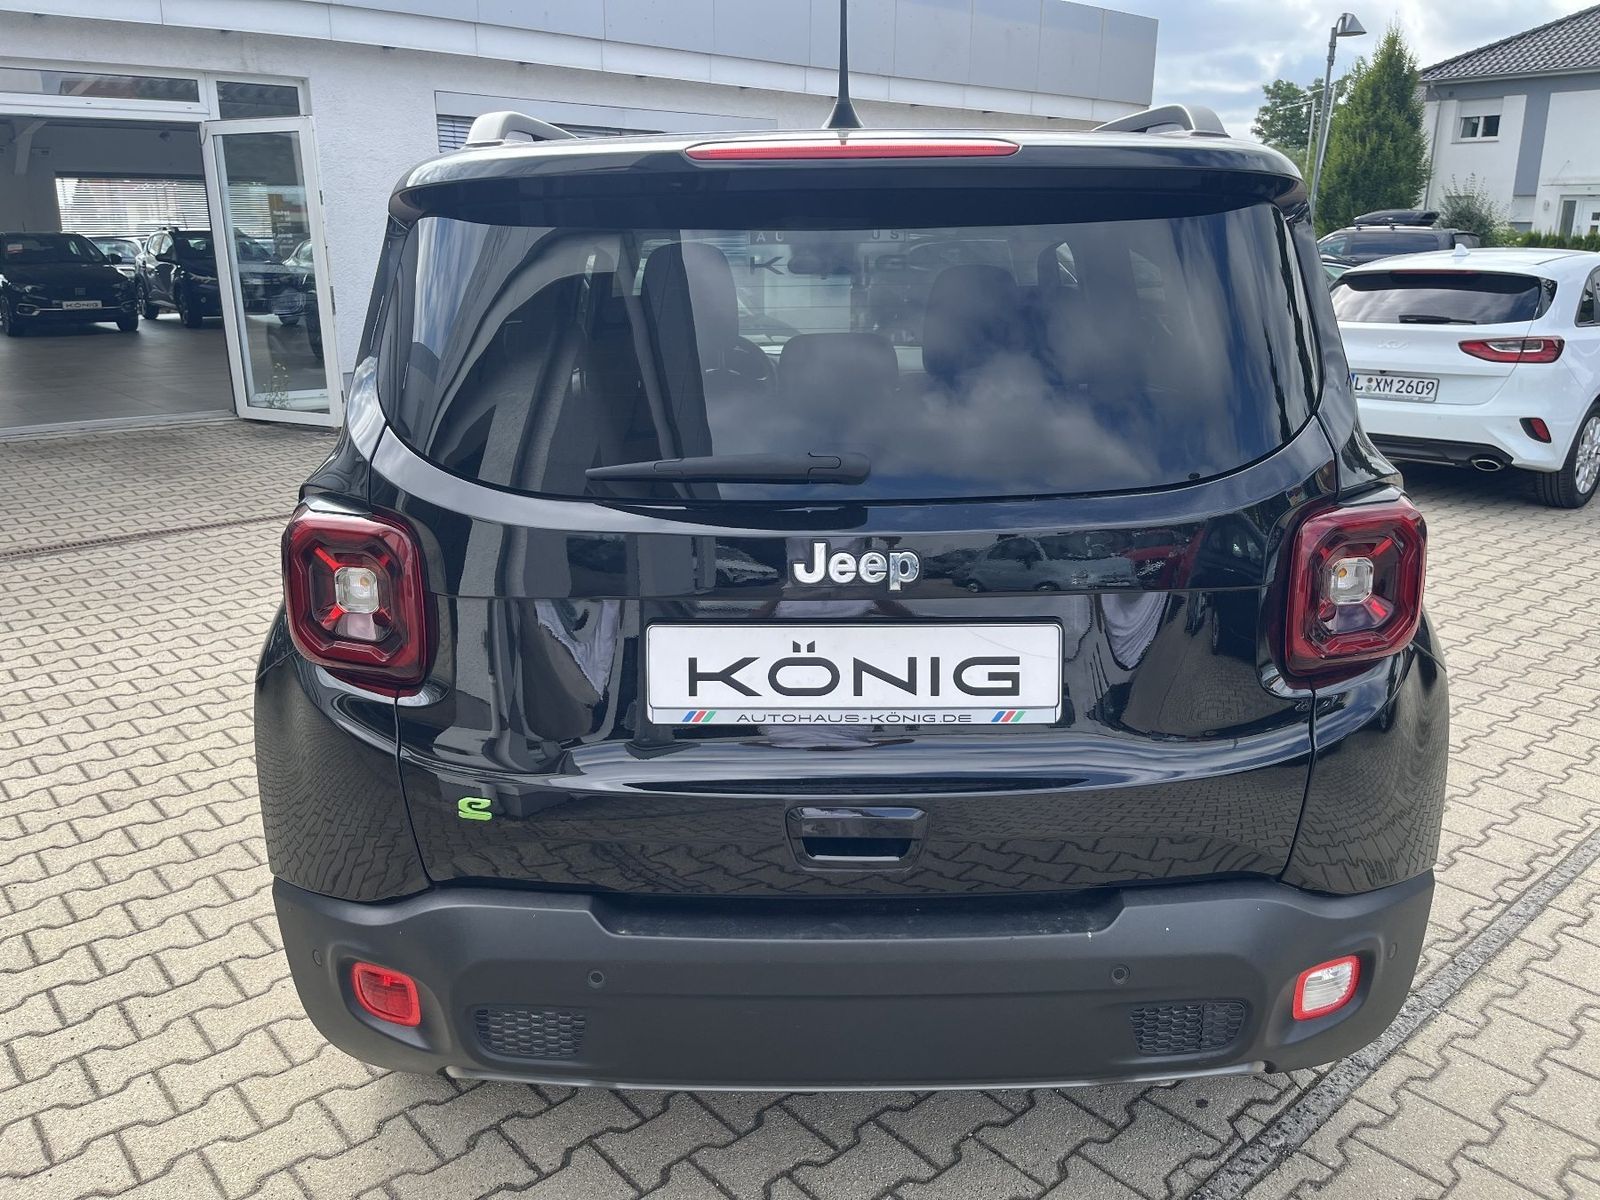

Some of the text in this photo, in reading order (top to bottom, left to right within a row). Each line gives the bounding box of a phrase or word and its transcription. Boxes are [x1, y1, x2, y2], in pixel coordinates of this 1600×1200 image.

[1395, 379, 1435, 396] 2609
[793, 542, 920, 591] Jeep
[688, 640, 1021, 698] KÖNIG
[736, 711, 973, 724] AUTOHAUS-KÖNIG.DE
